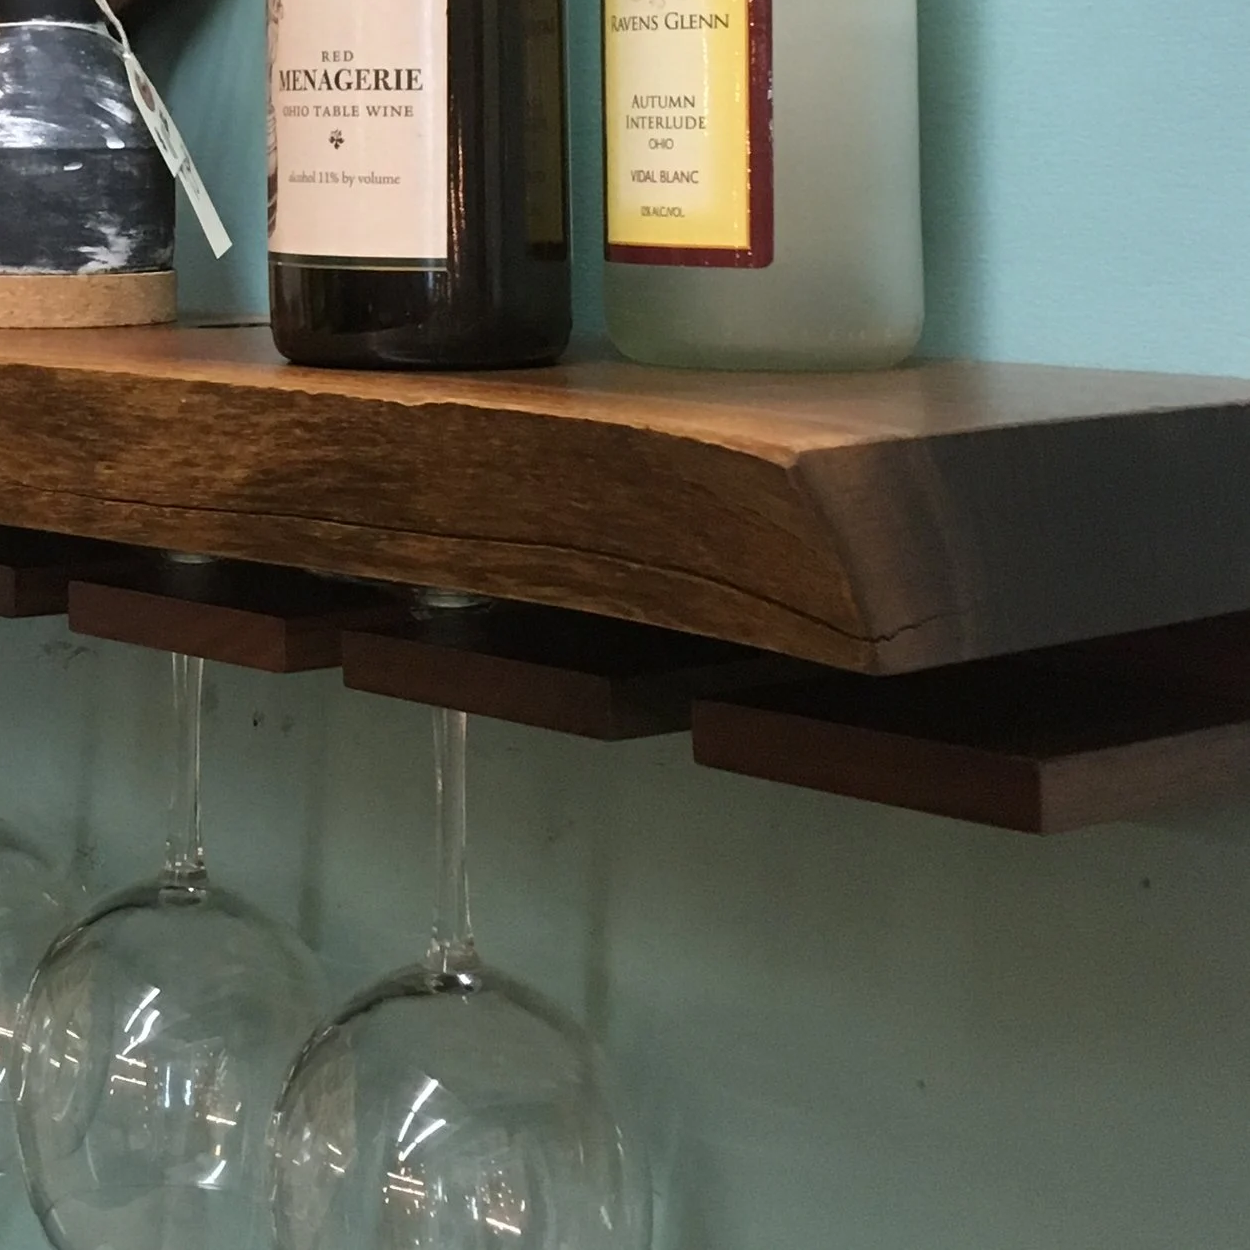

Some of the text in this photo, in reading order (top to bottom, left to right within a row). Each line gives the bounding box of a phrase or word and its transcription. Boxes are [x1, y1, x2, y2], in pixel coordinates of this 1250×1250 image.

[611, 12, 730, 32] RAVENS GLENN
[321, 50, 354, 63] RED
[279, 67, 424, 92] MENAGERIE
[631, 94, 696, 110] AUTUMN
[282, 105, 414, 118] OHIO TABLE WINE
[625, 114, 707, 130] INTERLUDE
[648, 137, 674, 150] OHIO
[341, 171, 355, 188] by
[357, 171, 401, 186] volume
[630, 170, 700, 184] VIDAL BLANC
